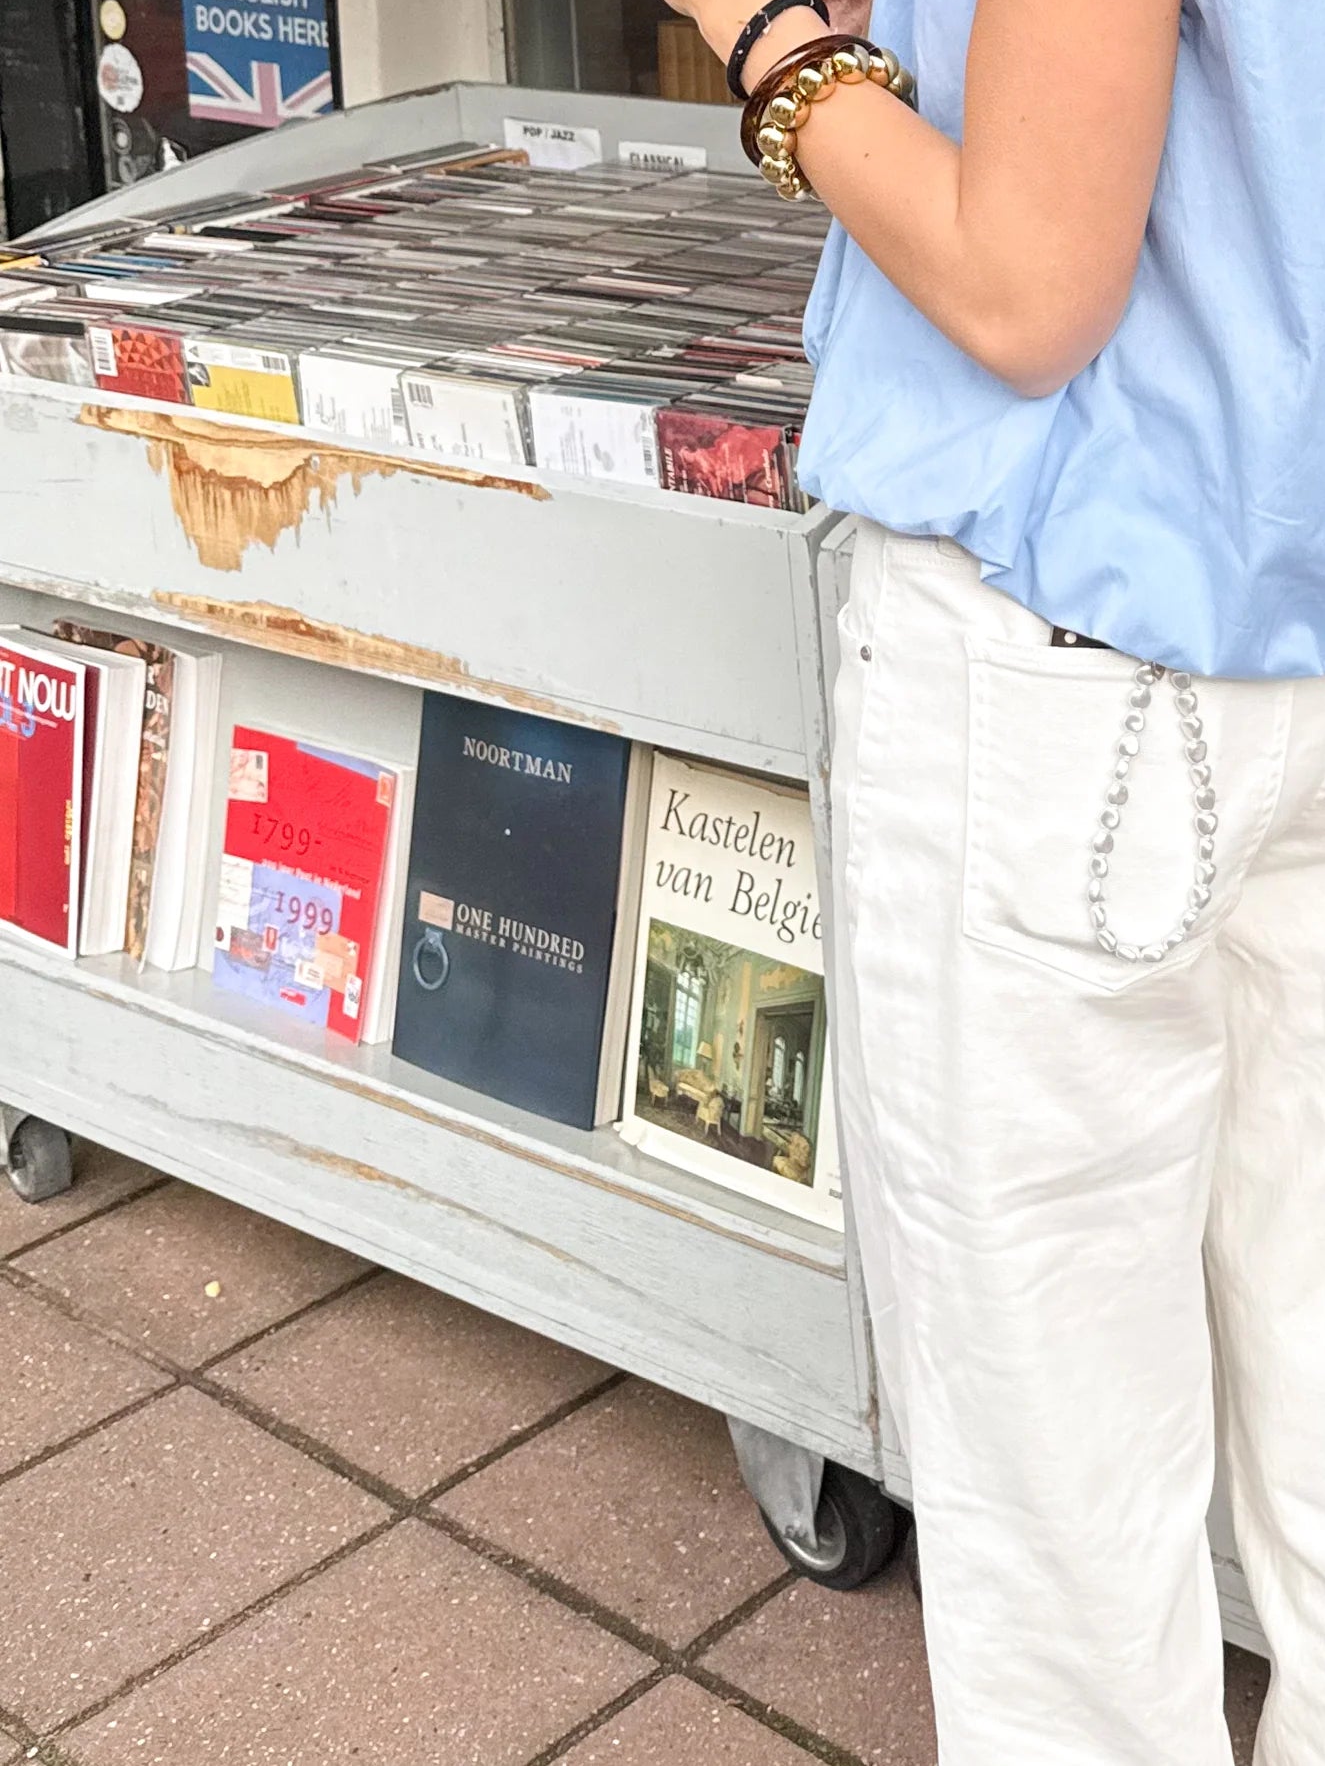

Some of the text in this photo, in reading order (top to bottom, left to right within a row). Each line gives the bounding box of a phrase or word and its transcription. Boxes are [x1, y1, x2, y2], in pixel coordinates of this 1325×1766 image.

[195, 4, 273, 40] BOOKS
[17, 669, 76, 722] NOW
[462, 735, 574, 785] NOORTMAN
[660, 787, 797, 869] Kastelen
[655, 858, 714, 904] van
[273, 890, 335, 936] 1999
[456, 903, 586, 962] ONE HUNDRED
[455, 924, 585, 975] MASTER PAINTINGS
